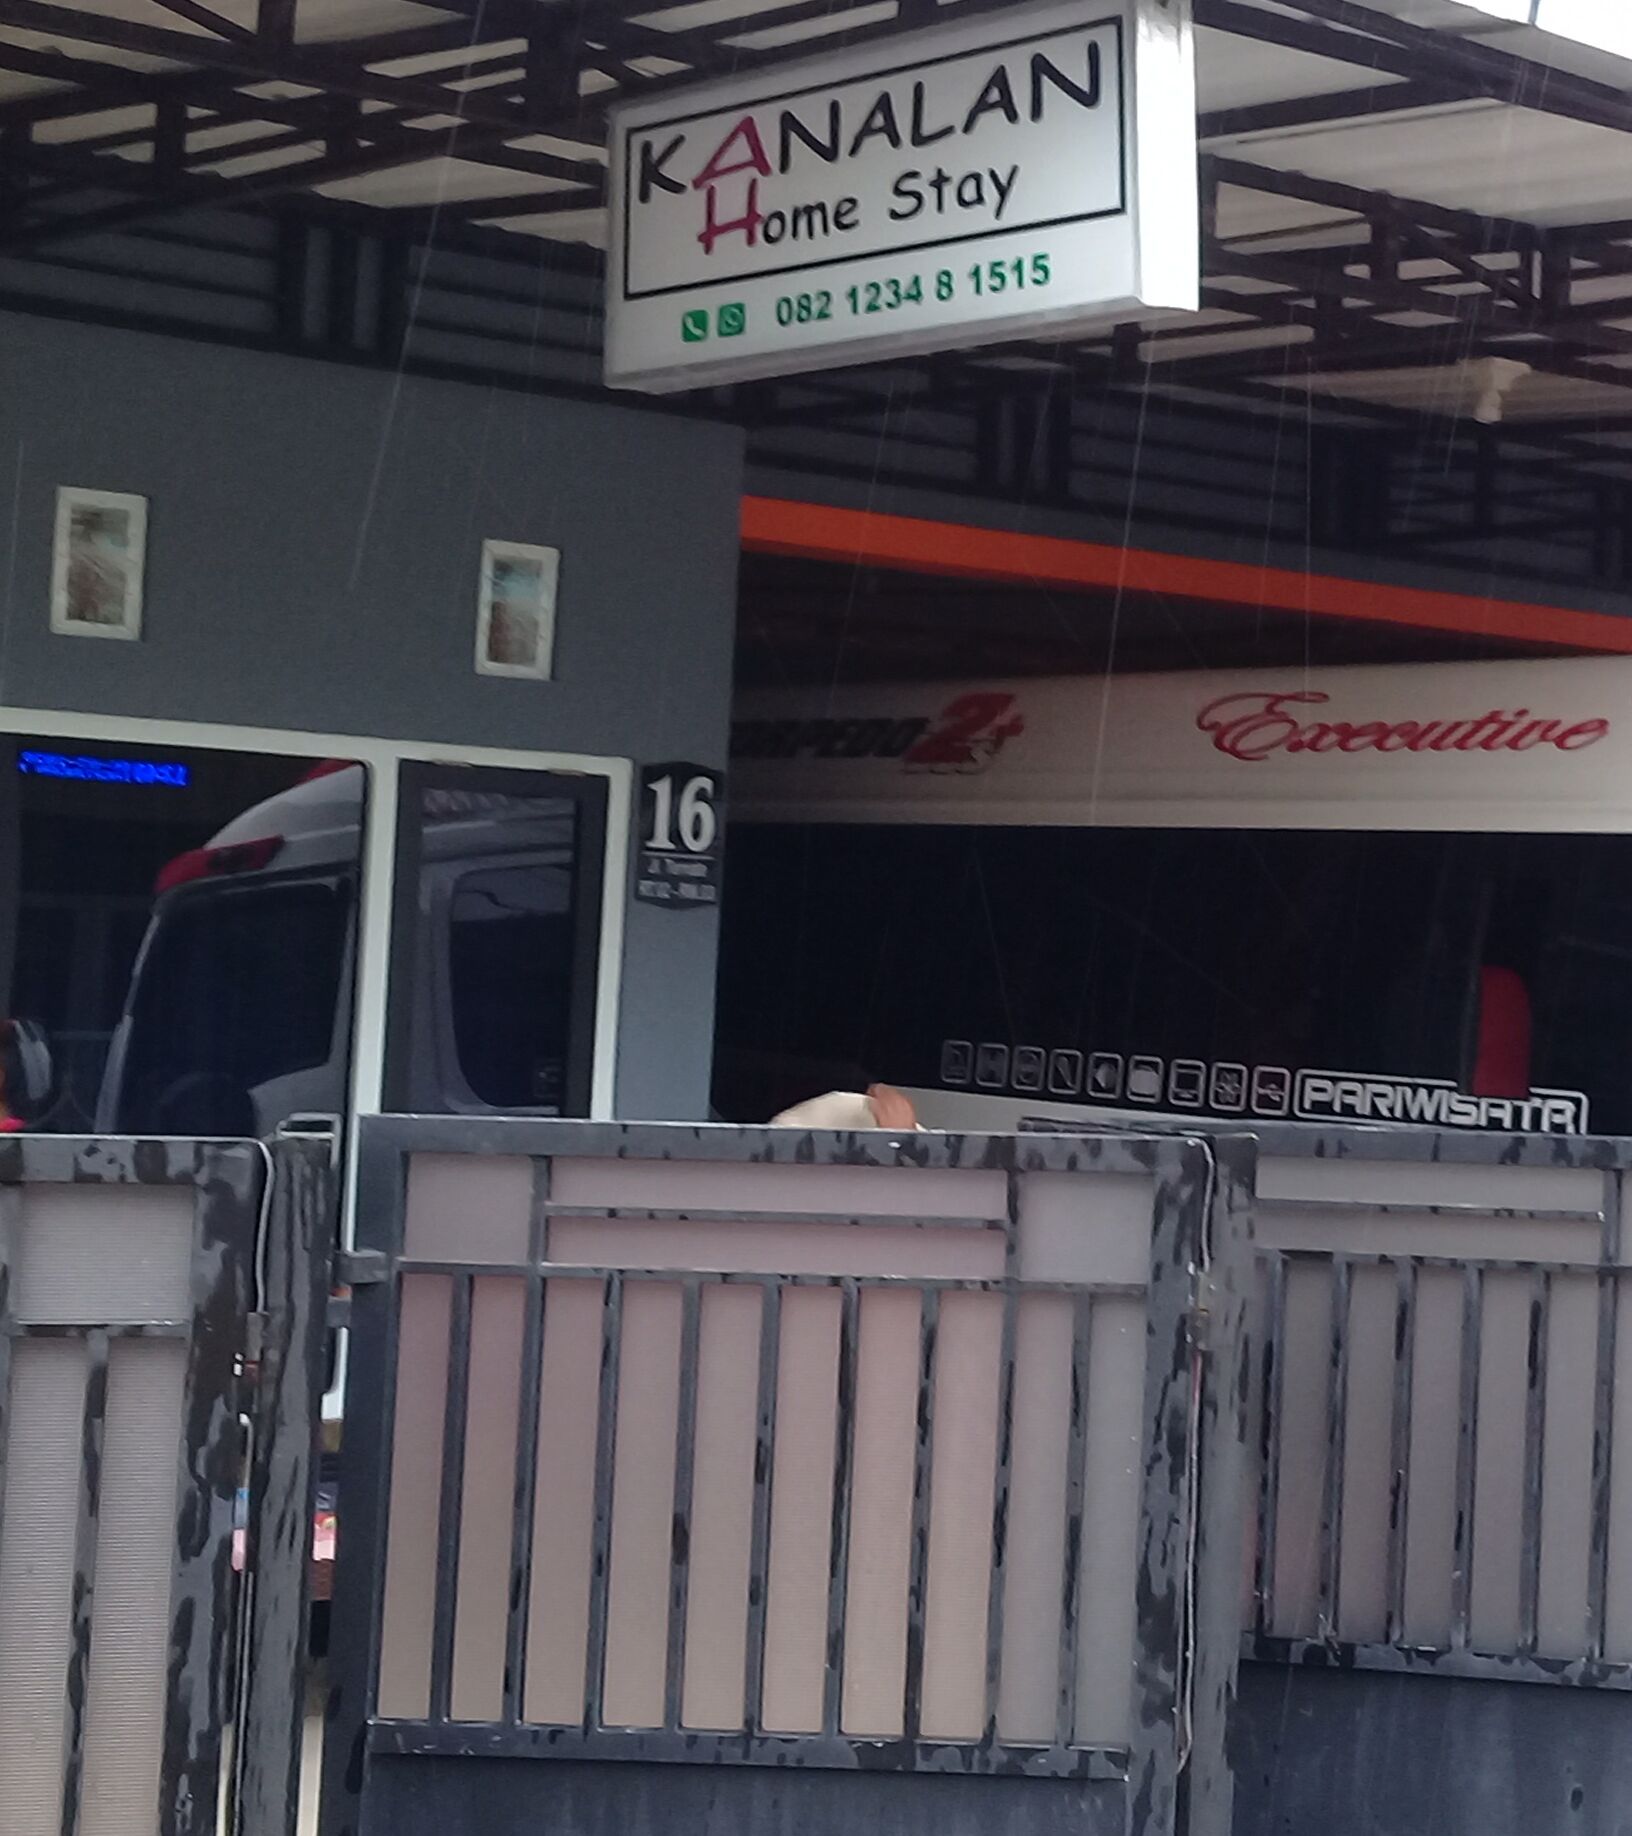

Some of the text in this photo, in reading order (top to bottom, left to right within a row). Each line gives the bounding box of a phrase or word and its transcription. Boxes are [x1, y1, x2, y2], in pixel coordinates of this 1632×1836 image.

[638, 41, 1100, 204] KANALAN
[697, 165, 1018, 255] Home Stay
[776, 254, 1051, 327] 082 1234 8 1515
[1196, 692, 1609, 761] Executive
[645, 774, 716, 852] 16
[1303, 1078, 1577, 1134] PARIWISATA
